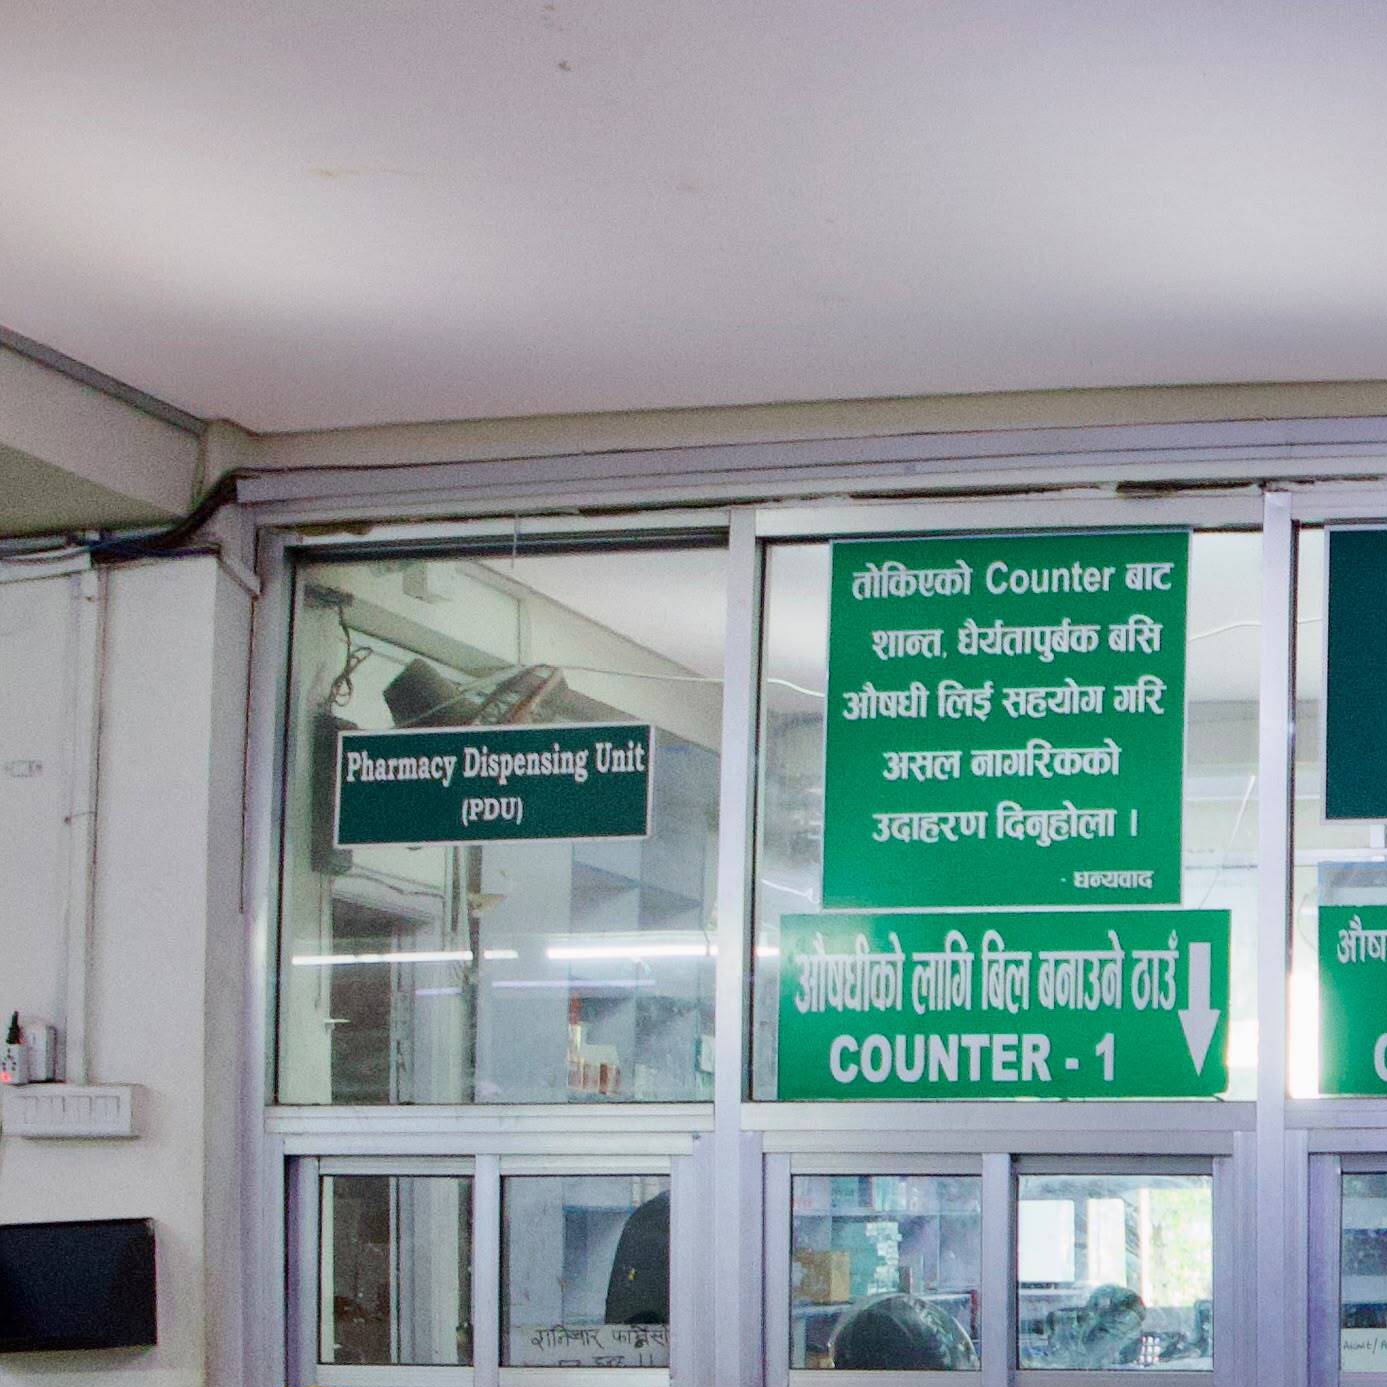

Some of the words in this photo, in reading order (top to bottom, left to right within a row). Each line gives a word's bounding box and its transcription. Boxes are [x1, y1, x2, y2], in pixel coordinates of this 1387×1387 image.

[853, 561, 973, 601] तोकिएको
[985, 561, 1116, 595] Counter
[1125, 561, 1174, 591] बाट
[1108, 614, 1163, 654] बसि
[842, 681, 929, 721] औषधी
[937, 680, 994, 721] लिई
[1002, 678, 1105, 718] सहयोग
[1113, 675, 1167, 715] गरि
[346, 750, 457, 788] Pharmacy
[463, 743, 589, 784] Dispensing
[595, 739, 645, 773] Unit
[882, 751, 963, 782] असल
[971, 738, 1122, 779] नागरिकको
[461, 797, 524, 826] (PDU)
[872, 811, 988, 843] उदाहरण
[997, 800, 1117, 847] दिनुहोला
[1073, 870, 1154, 889] धन्यवाद
[794, 931, 905, 1014] औषधीको
[912, 929, 975, 1015] लागि
[981, 928, 1032, 1014] बिल
[1038, 929, 1124, 1012] बनाउने
[1131, 928, 1179, 1011] ठाउँ
[829, 1033, 1052, 1083] COUNTER
[1095, 1033, 1115, 1081] 1
